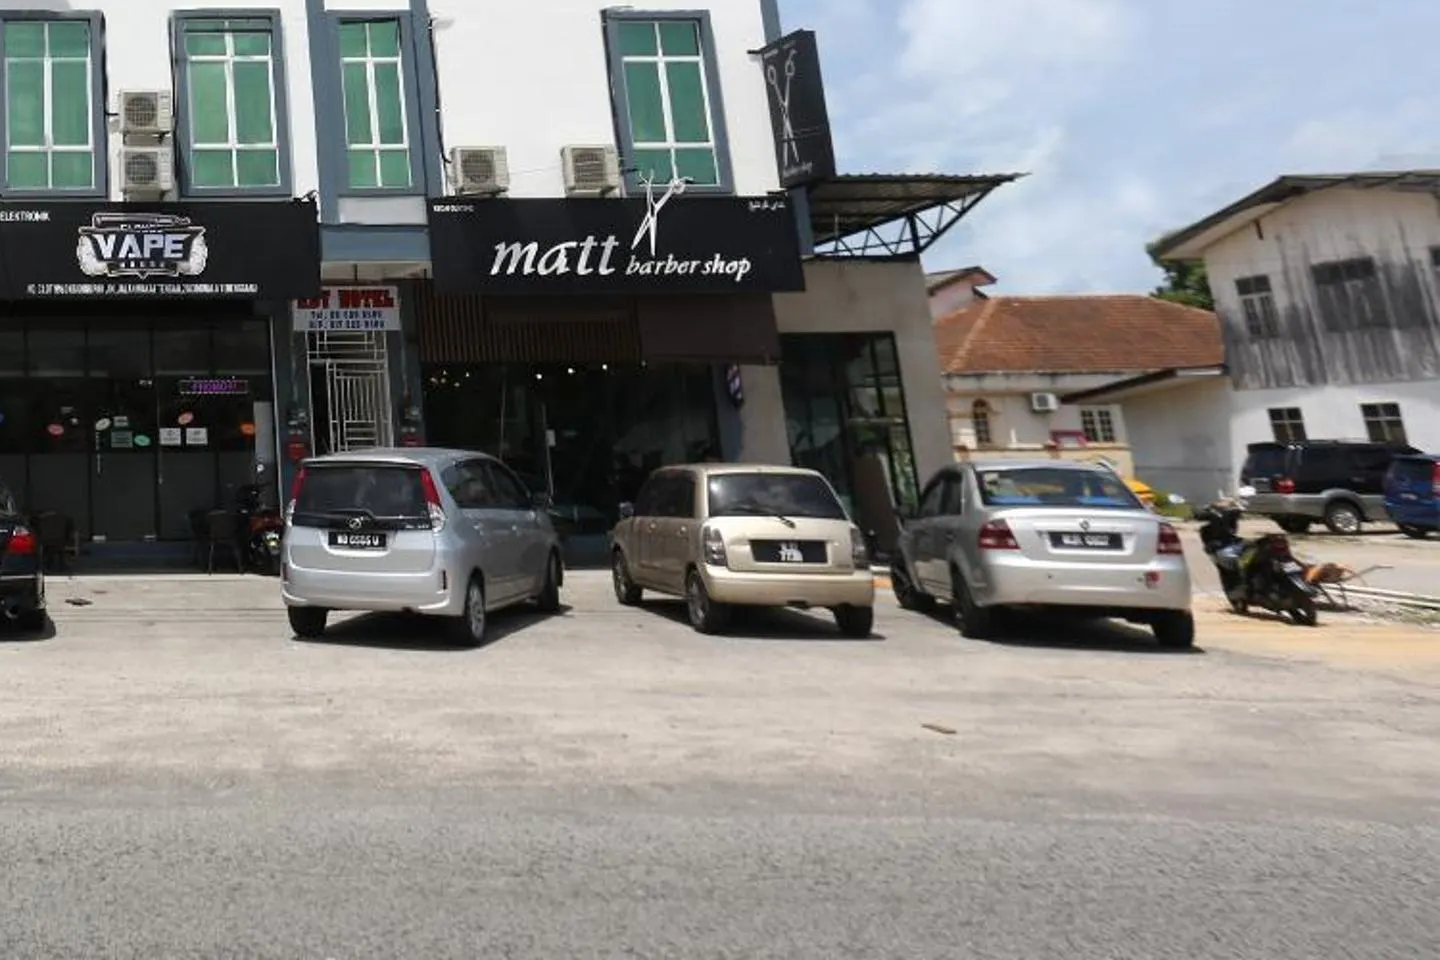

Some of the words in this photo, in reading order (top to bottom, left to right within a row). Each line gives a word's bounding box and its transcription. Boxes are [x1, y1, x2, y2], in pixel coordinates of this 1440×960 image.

[92, 233, 192, 260] VAPE
[490, 235, 620, 276] matt
[625, 253, 701, 276] barber
[701, 253, 752, 282] shop
